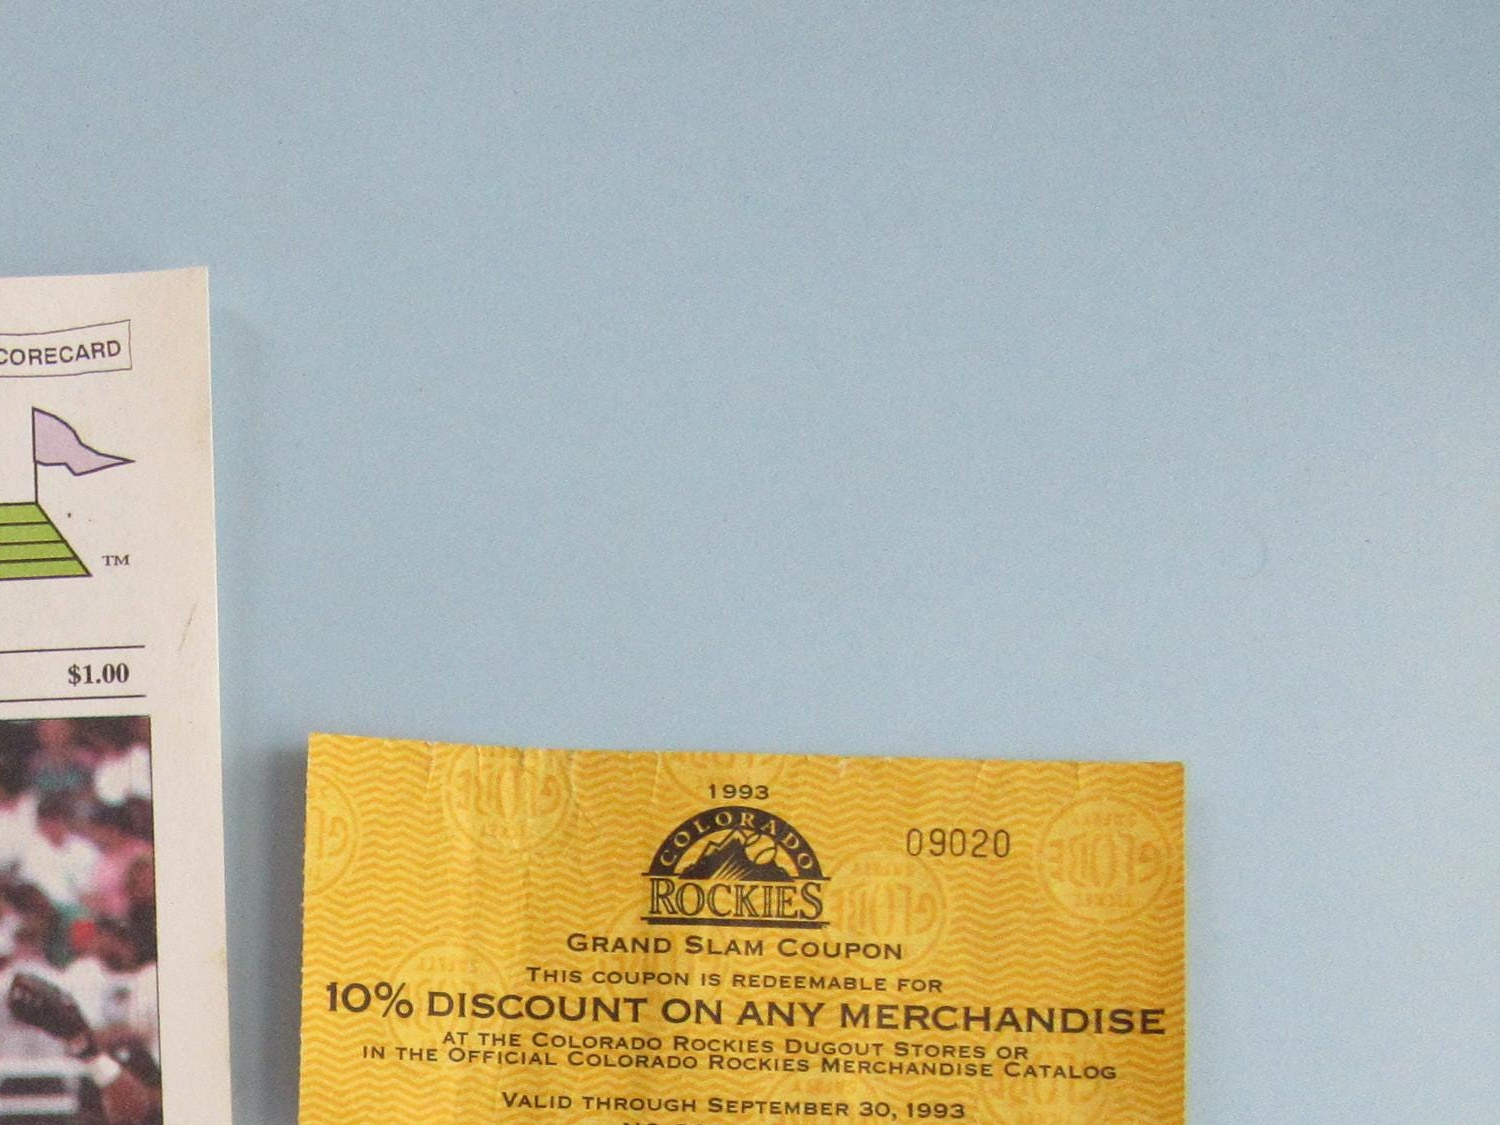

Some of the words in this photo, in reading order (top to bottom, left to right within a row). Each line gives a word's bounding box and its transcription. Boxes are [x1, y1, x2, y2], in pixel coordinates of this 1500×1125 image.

[67, 662, 130, 687] $1.00
[709, 784, 769, 799] 1993
[660, 811, 813, 869] COLORADO
[906, 828, 1010, 858] 09020
[650, 877, 823, 920] ROCKIES
[567, 933, 671, 954] GRAND
[685, 936, 763, 956] SLAM
[778, 938, 902, 960] COUPON
[527, 967, 581, 984] THIS
[592, 970, 689, 986] COUPON
[701, 972, 720, 986] IS
[732, 973, 886, 991] REDEEMABLE
[898, 979, 942, 993] FOR
[326, 981, 413, 1018] 10%
[429, 990, 647, 1023] DISCOUNT
[662, 998, 722, 1024] ON
[735, 1001, 825, 1028] ANY
[841, 1003, 1165, 1034] MERCHANDISE
[443, 1032, 468, 1046] AT
[478, 1033, 521, 1047] THE
[532, 1033, 662, 1051] COLORADO
[674, 1036, 773, 1053] ROCKIES
[786, 1039, 883, 1057] DUGOUT
[895, 1041, 985, 1058] STORES
[997, 1045, 1028, 1060] OR
[363, 1045, 385, 1059] IN
[396, 1046, 438, 1061] THE
[449, 1047, 556, 1066] OFFICIAL
[567, 1051, 697, 1069] COLORADO
[709, 1054, 808, 1072] ROCKIES
[822, 1058, 993, 1077] MERCHANDISE
[1004, 1061, 1116, 1079] CATALOG
[501, 1092, 571, 1109] VALID
[583, 1096, 696, 1113] THROUGH
[708, 1097, 848, 1117] SEPTEMBER
[860, 1102, 897, 1120] 30,
[906, 1103, 965, 1119] 1993
